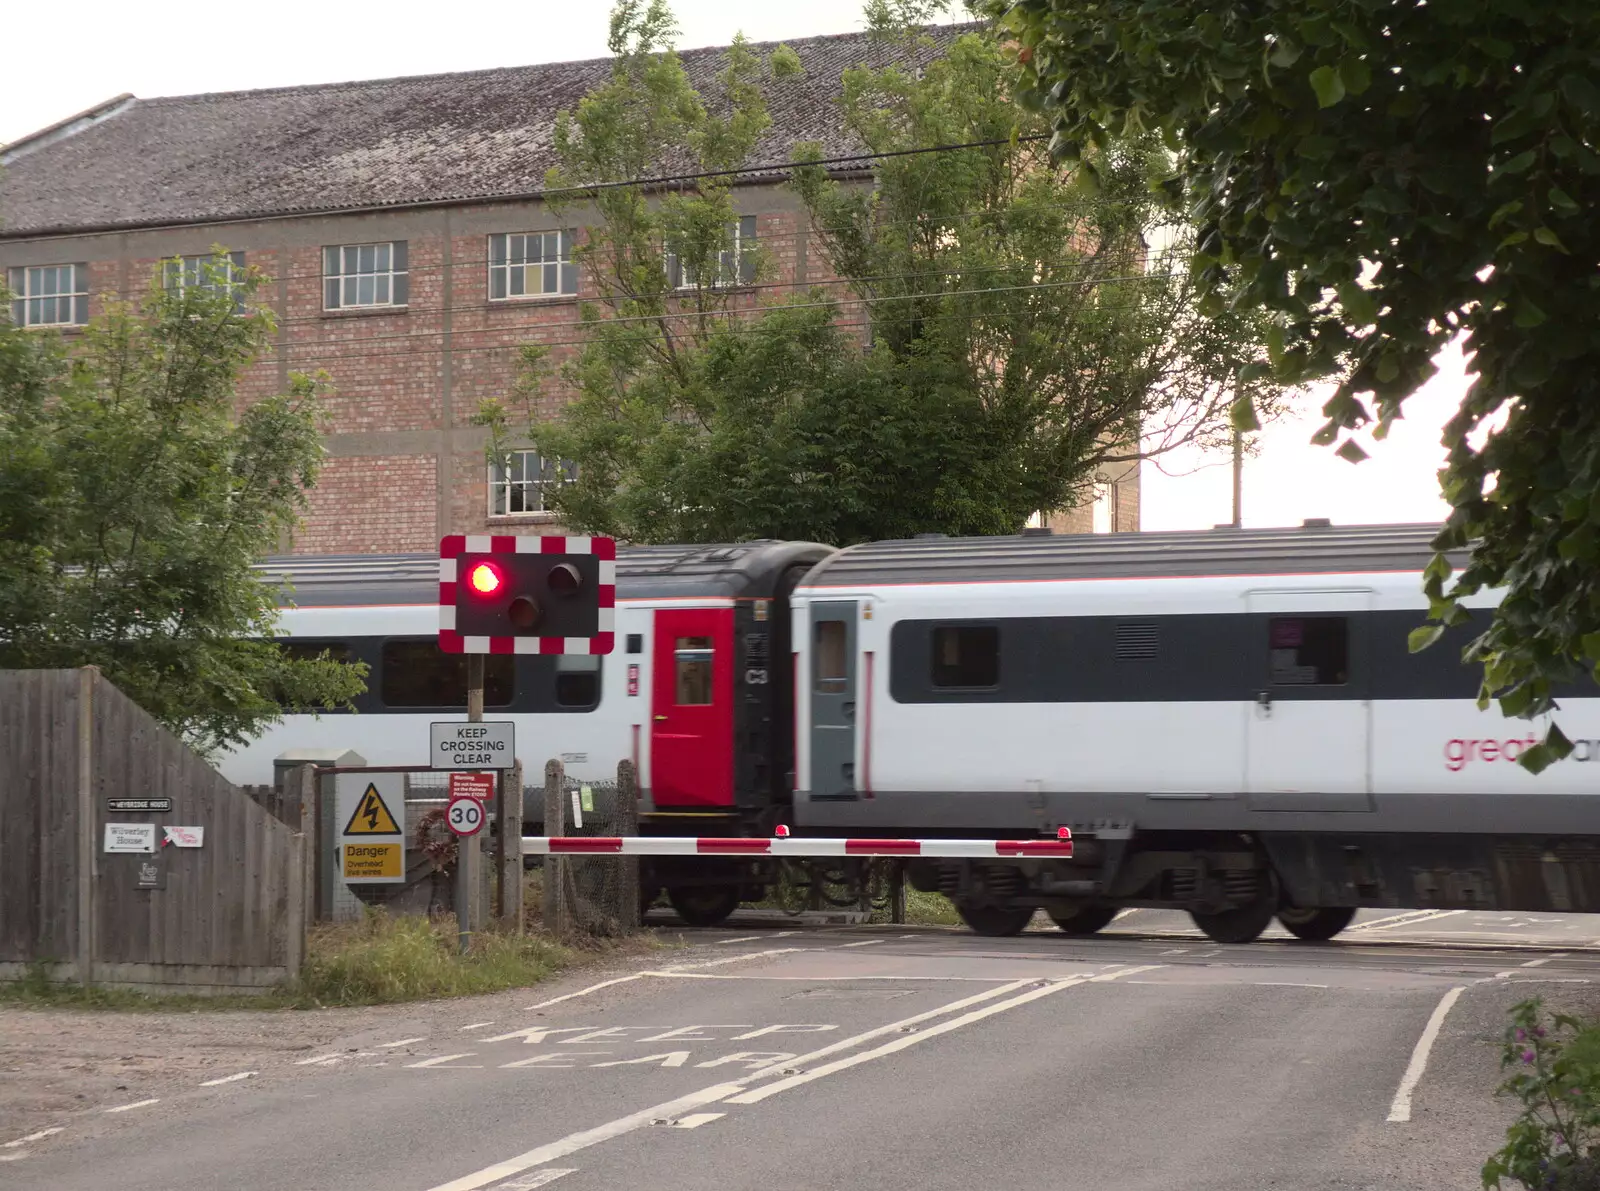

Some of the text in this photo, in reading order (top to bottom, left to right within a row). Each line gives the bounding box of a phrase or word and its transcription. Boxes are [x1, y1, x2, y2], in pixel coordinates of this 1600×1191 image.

[457, 728, 488, 738] KEEP
[440, 741, 505, 751] CROSSING
[453, 754, 492, 764] CLEAR
[451, 808, 479, 824] 30
[347, 846, 389, 857] Danger
[478, 1024, 840, 1043] KEEP
